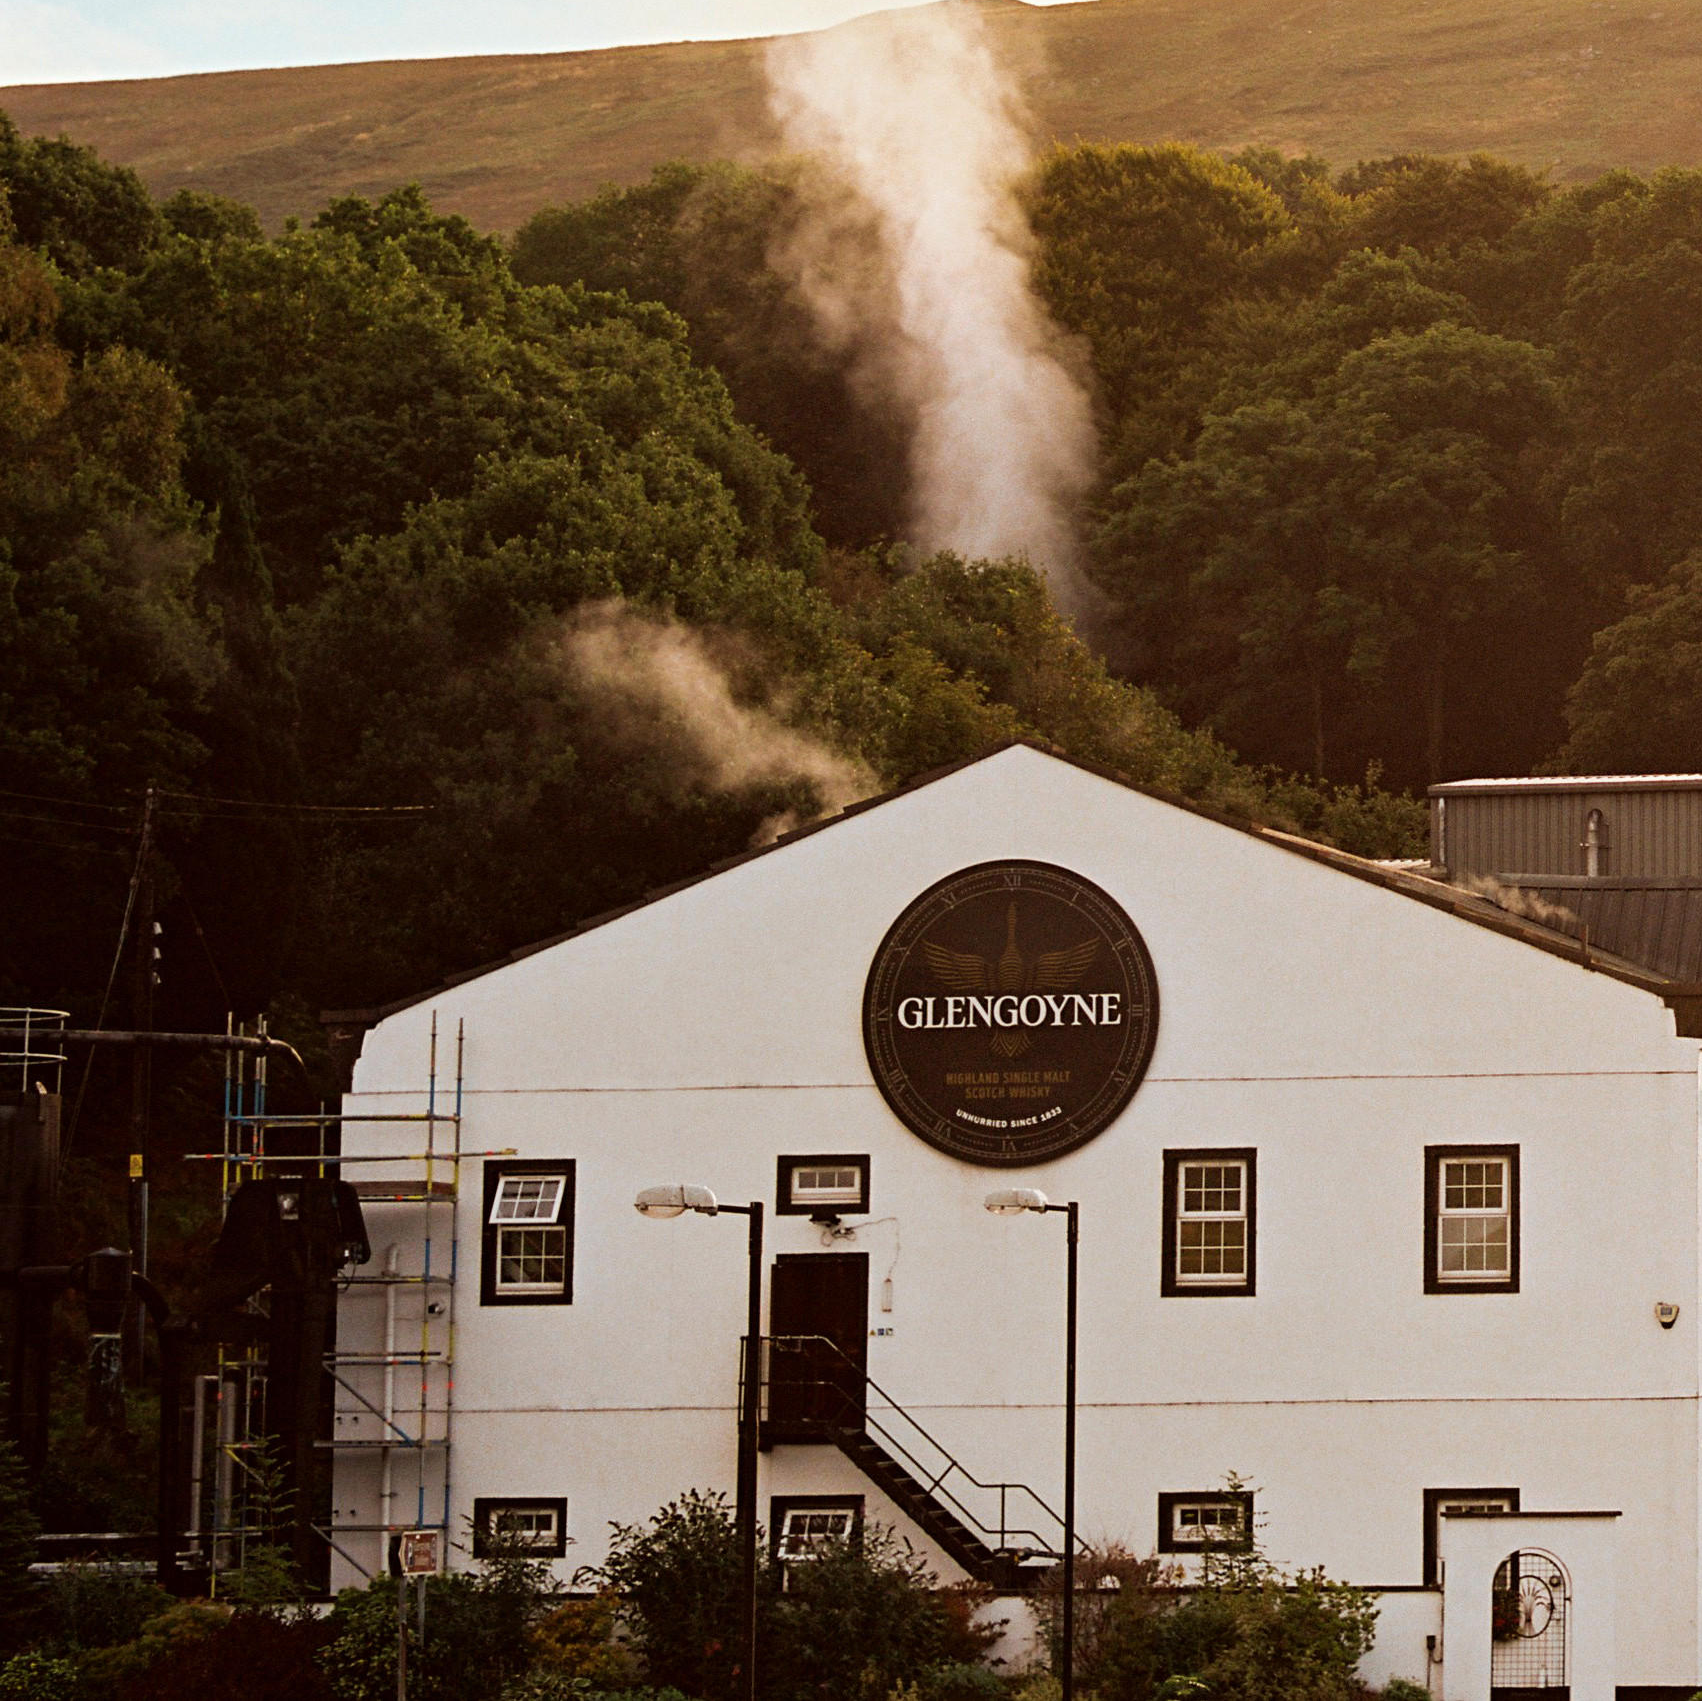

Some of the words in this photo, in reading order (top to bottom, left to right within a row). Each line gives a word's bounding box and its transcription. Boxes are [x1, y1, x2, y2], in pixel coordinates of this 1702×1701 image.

[1003, 875, 1021, 886] XII
[897, 993, 1122, 1029] GLENGOYNE
[946, 1072, 999, 1084] HIGHLAND
[1003, 1071, 1040, 1084] SINGLE
[1043, 1070, 1071, 1083] MALT
[965, 1086, 1005, 1099] SCOTCH
[1009, 1086, 1051, 1098] WHISKY
[956, 1108, 1007, 1128] UNHURRIED
[1010, 1115, 1038, 1128] SINCE
[1040, 1106, 1062, 1122] 1833
